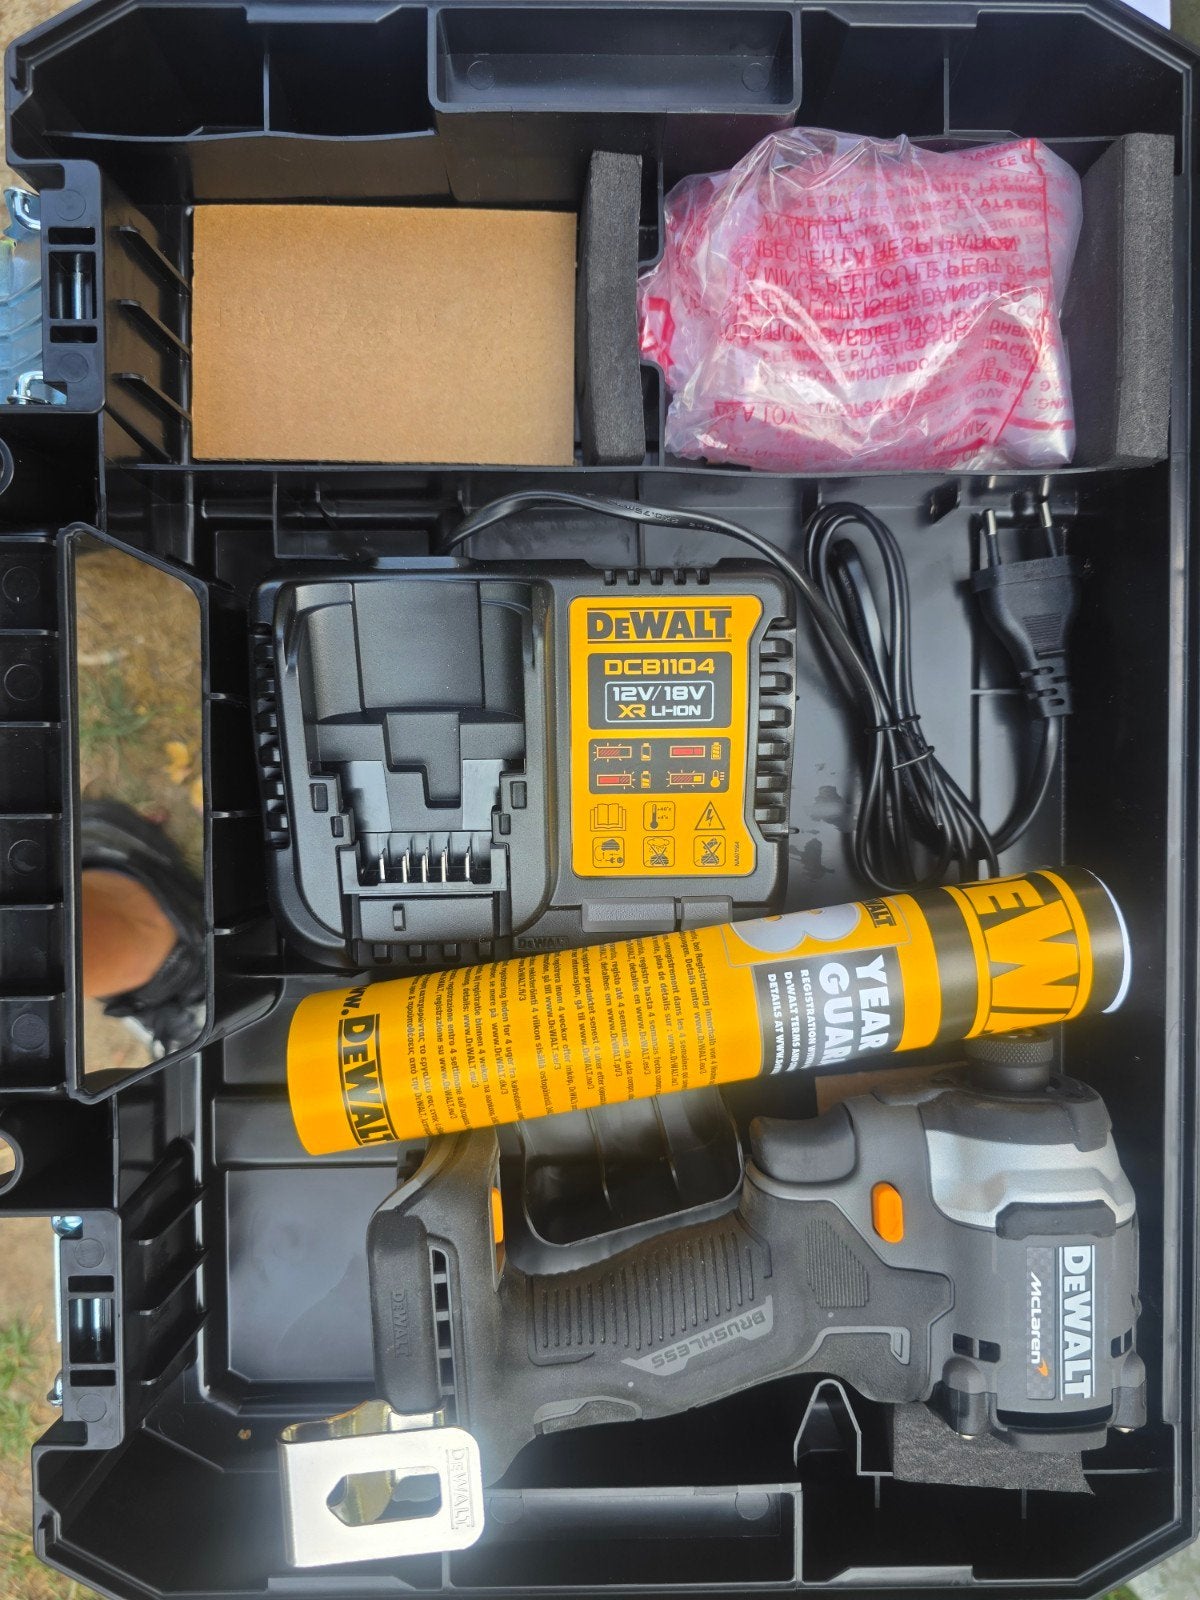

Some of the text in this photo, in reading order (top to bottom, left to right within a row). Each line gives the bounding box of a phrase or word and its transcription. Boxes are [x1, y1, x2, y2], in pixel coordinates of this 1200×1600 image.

[604, 658, 715, 676] DCB1104
[618, 703, 702, 718] XR LI-ION
[640, 956, 651, 984] registro
[654, 954, 664, 970] plus
[658, 970, 666, 981] de
[684, 958, 697, 986] Details
[628, 962, 640, 992] detalles
[634, 994, 642, 1004] en
[695, 952, 711, 1006] Registrierung
[490, 988, 498, 1008] mere
[555, 984, 564, 1004] inom
[574, 999, 584, 1010] gå
[584, 976, 596, 1014] produktet
[606, 993, 613, 1006] em
[644, 986, 654, 1010] hasta
[673, 994, 682, 1016] dans
[690, 986, 700, 1010] unter
[768, 974, 782, 1018] DETAILS
[800, 970, 816, 1044] REGISTRATION
[855, 954, 891, 1051] YEAR
[502, 1000, 510, 1022] inden
[676, 1018, 685, 1030] les
[448, 1024, 457, 1046] entro
[475, 1018, 484, 1047] binnen
[503, 1024, 512, 1037] for
[532, 1014, 542, 1041] viikon
[558, 1013, 570, 1042] veckor
[589, 1016, 601, 1044] senest
[648, 1019, 660, 1055] semanas
[774, 1020, 784, 1034] AT
[790, 1015, 801, 1048] TERMS
[506, 1046, 514, 1066] uger
[619, 1010, 630, 1047] semanas
[626, 1060, 634, 1075] data
[479, 1056, 489, 1083] weken
[595, 1053, 604, 1070] uker
[450, 1056, 462, 1095] settimane
[1030, 1271, 1042, 1364] McLaren
[651, 1309, 767, 1369] BRUSHLESS
